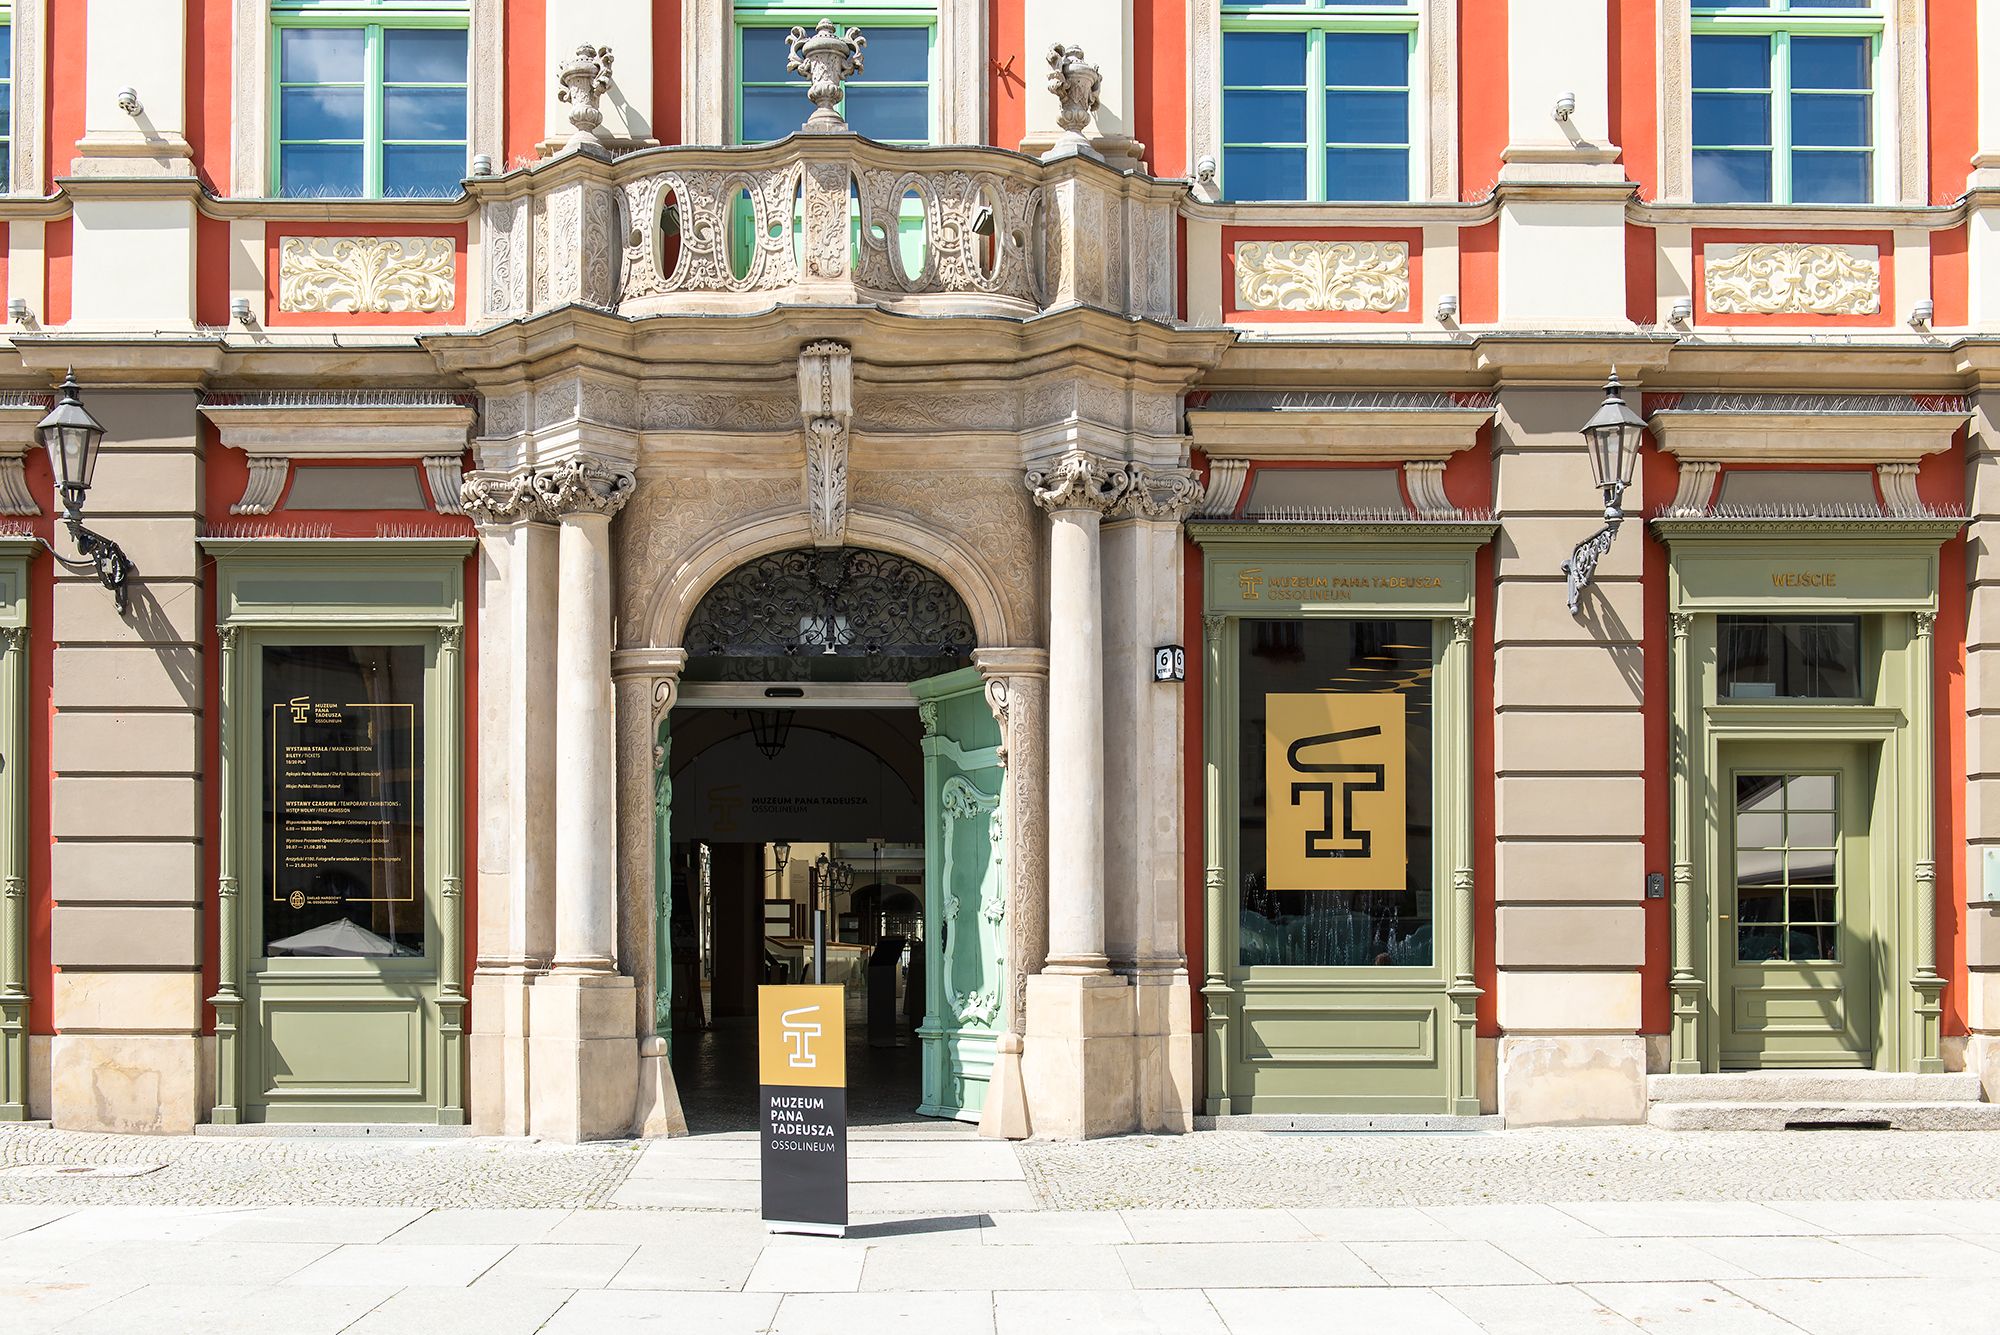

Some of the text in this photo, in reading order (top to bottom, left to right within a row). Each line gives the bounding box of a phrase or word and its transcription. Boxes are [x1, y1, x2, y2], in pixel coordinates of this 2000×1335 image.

[1268, 576, 1442, 588] MUZEUM PANA TADEUSZA
[1771, 570, 1836, 587] WEJŚCIE
[1268, 590, 1352, 601] OSSOLINEUM
[1161, 652, 1168, 666] 6
[1176, 652, 1182, 666] 6
[752, 805, 808, 813] OSSOLINEUM
[771, 1096, 824, 1109] MUZEUM
[771, 1110, 804, 1121] PANA
[772, 1124, 834, 1136] TADEUSZA
[772, 1140, 835, 1152] OSSOLINEUM
